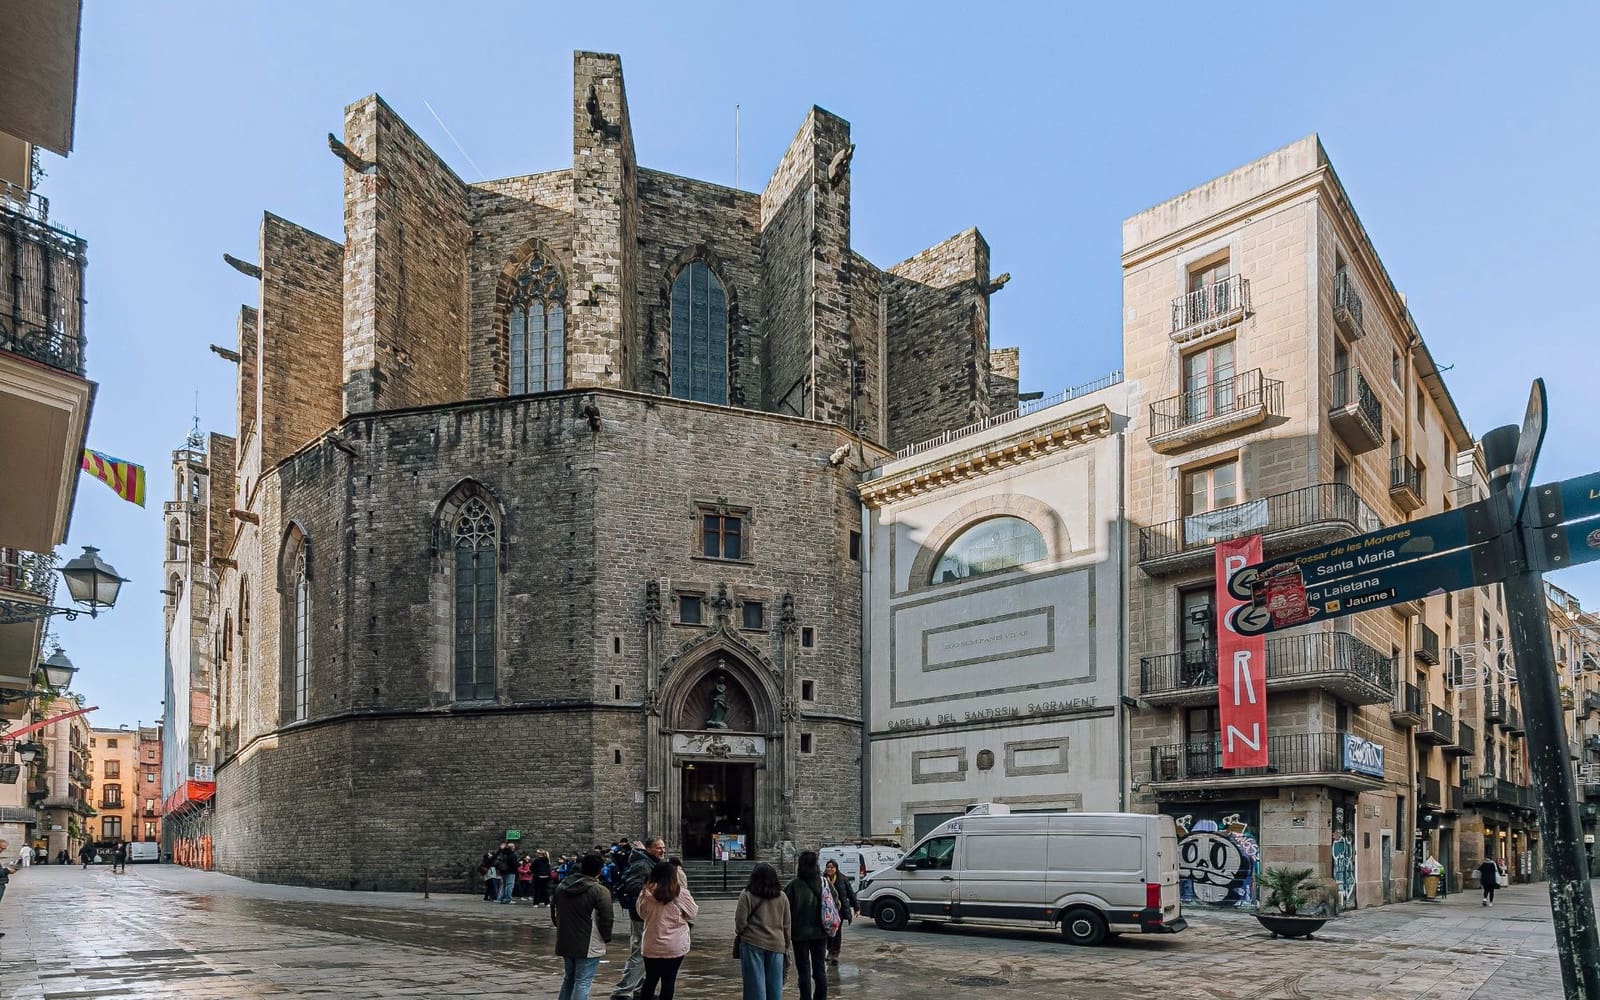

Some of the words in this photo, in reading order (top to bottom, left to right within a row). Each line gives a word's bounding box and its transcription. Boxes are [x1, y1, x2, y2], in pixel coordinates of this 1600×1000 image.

[1589, 488, 1600, 499] L
[1295, 551, 1328, 565] Fossar
[1330, 545, 1345, 556] de
[1346, 541, 1362, 552] les
[1364, 529, 1411, 548] Moreres
[1316, 559, 1354, 576] Santa
[1357, 549, 1396, 567] Maria
[1324, 577, 1380, 598] Laietana
[1345, 592, 1388, 608] Jaume
[887, 716, 931, 730] CAPELLA
[937, 713, 957, 724] DEL
[964, 706, 1019, 721] SANTISSIM
[1027, 696, 1098, 713] SAGRAMENT
